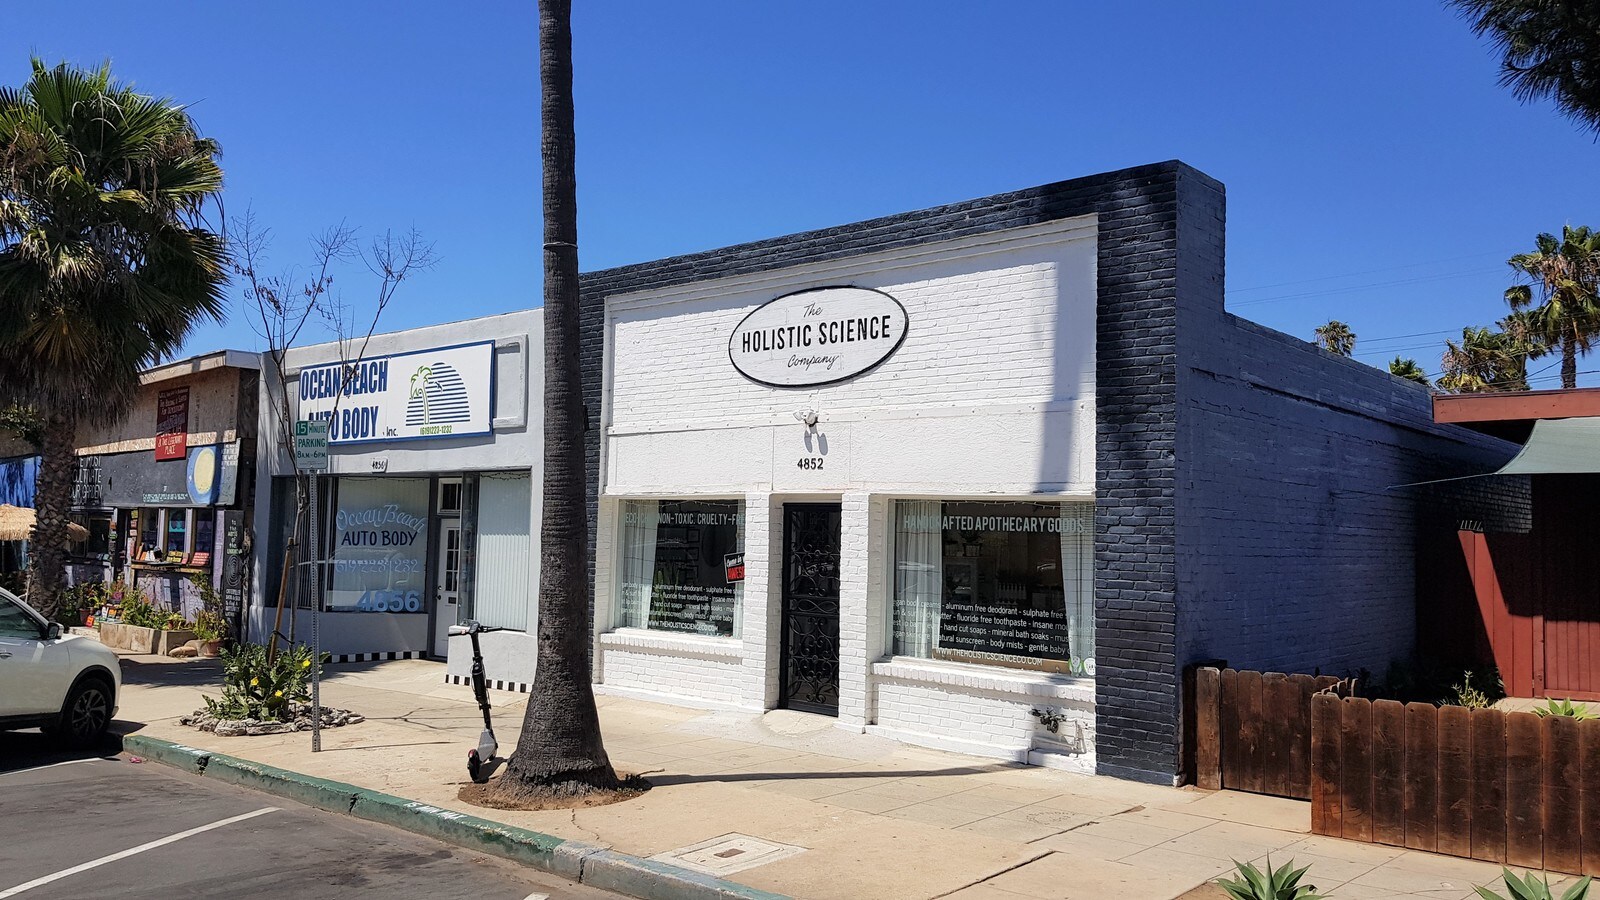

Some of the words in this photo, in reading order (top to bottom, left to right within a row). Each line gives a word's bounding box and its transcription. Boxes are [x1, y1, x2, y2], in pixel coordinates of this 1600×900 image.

[804, 302, 823, 317] The
[742, 325, 812, 353] HOLISTIC
[818, 315, 891, 345] SCIENCE
[787, 354, 840, 371] Company
[301, 366, 341, 401] OCEAN
[343, 360, 389, 396] BEACH
[297, 423, 307, 434] 15
[309, 425, 326, 433] MINUTE
[342, 406, 379, 439] BODY
[298, 438, 326, 448] PARKING
[797, 457, 824, 470] 4852
[336, 508, 381, 530] Ocean
[381, 504, 427, 533] Beach
[975, 516, 1045, 532] APOTHECARY
[341, 531, 377, 546] AUTO
[381, 531, 418, 546] BODY
[945, 602, 974, 611] aluminum
[975, 604, 986, 613] free
[987, 605, 1018, 615] deodorant
[1023, 609, 1049, 618] sulphate
[1051, 610, 1063, 619] free
[957, 613, 979, 622] fluoride
[980, 615, 992, 624] free
[994, 617, 1027, 627] toothpaste
[1032, 620, 1054, 630] insane
[943, 622, 958, 632] hand
[959, 625, 969, 633] cut
[970, 627, 987, 635] soaps
[992, 629, 1014, 637] mineral
[1016, 630, 1030, 639] bath
[1031, 632, 1050, 641] soaks
[955, 636, 986, 645] sunscreen
[990, 639, 1005, 649] body
[1006, 641, 1024, 650] mists
[1028, 643, 1049, 653] gentle
[1050, 644, 1066, 655] baby
